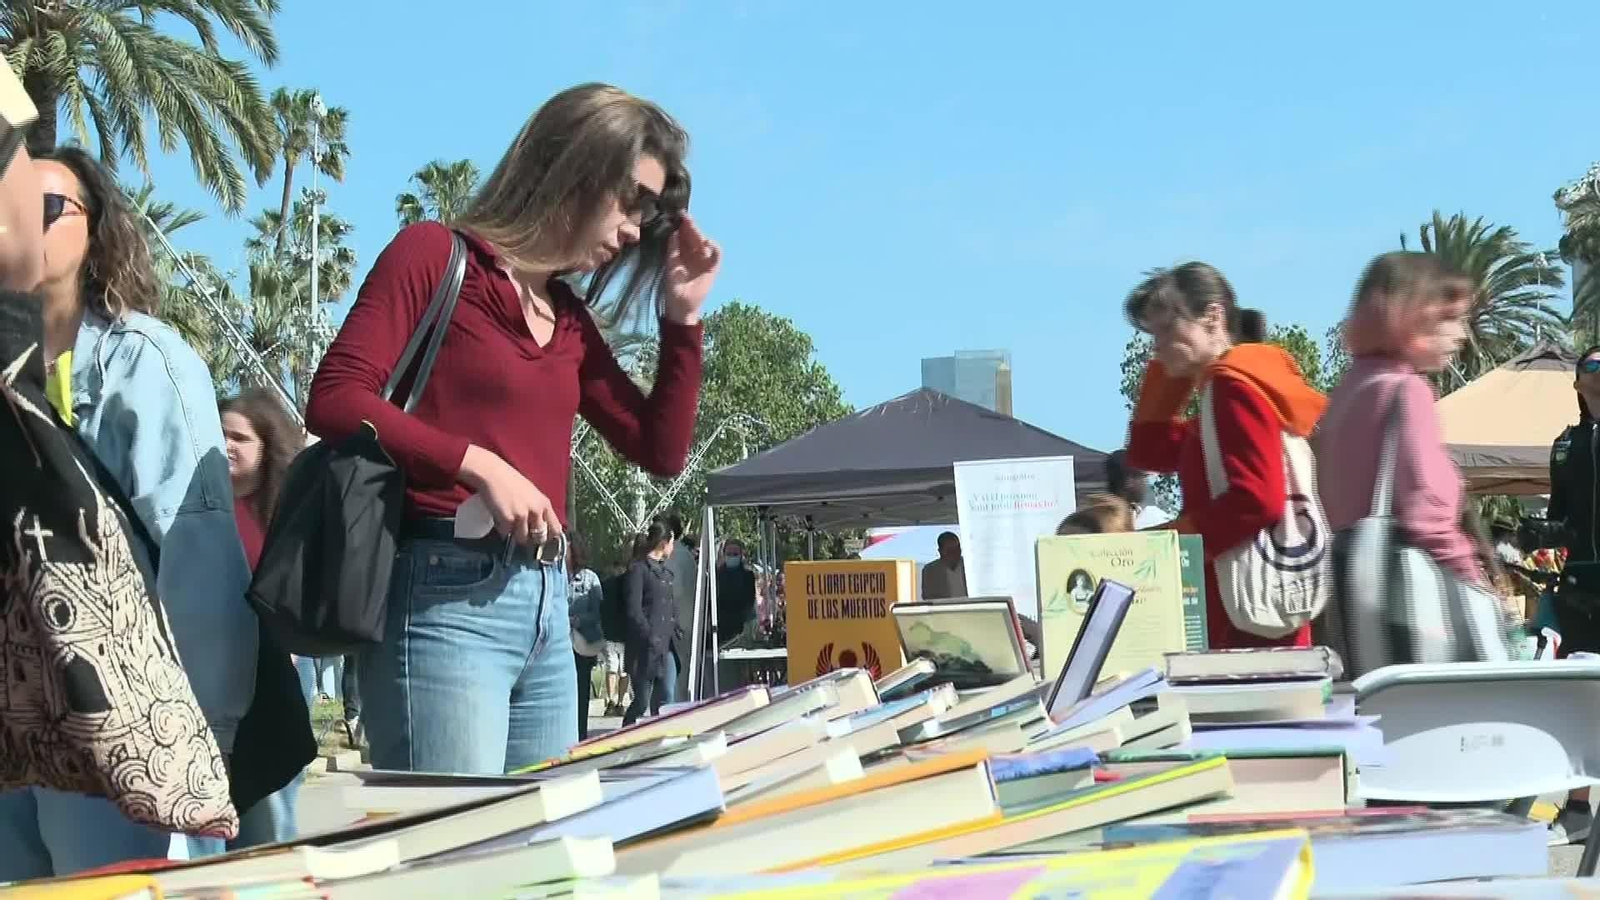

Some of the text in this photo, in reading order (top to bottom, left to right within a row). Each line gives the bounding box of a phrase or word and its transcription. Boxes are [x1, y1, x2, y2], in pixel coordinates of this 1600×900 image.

[1110, 556, 1135, 567] Oro
[806, 572, 886, 595] EL LIBRO EGIPCIO
[807, 597, 887, 619] DE LOS MUERTOS
